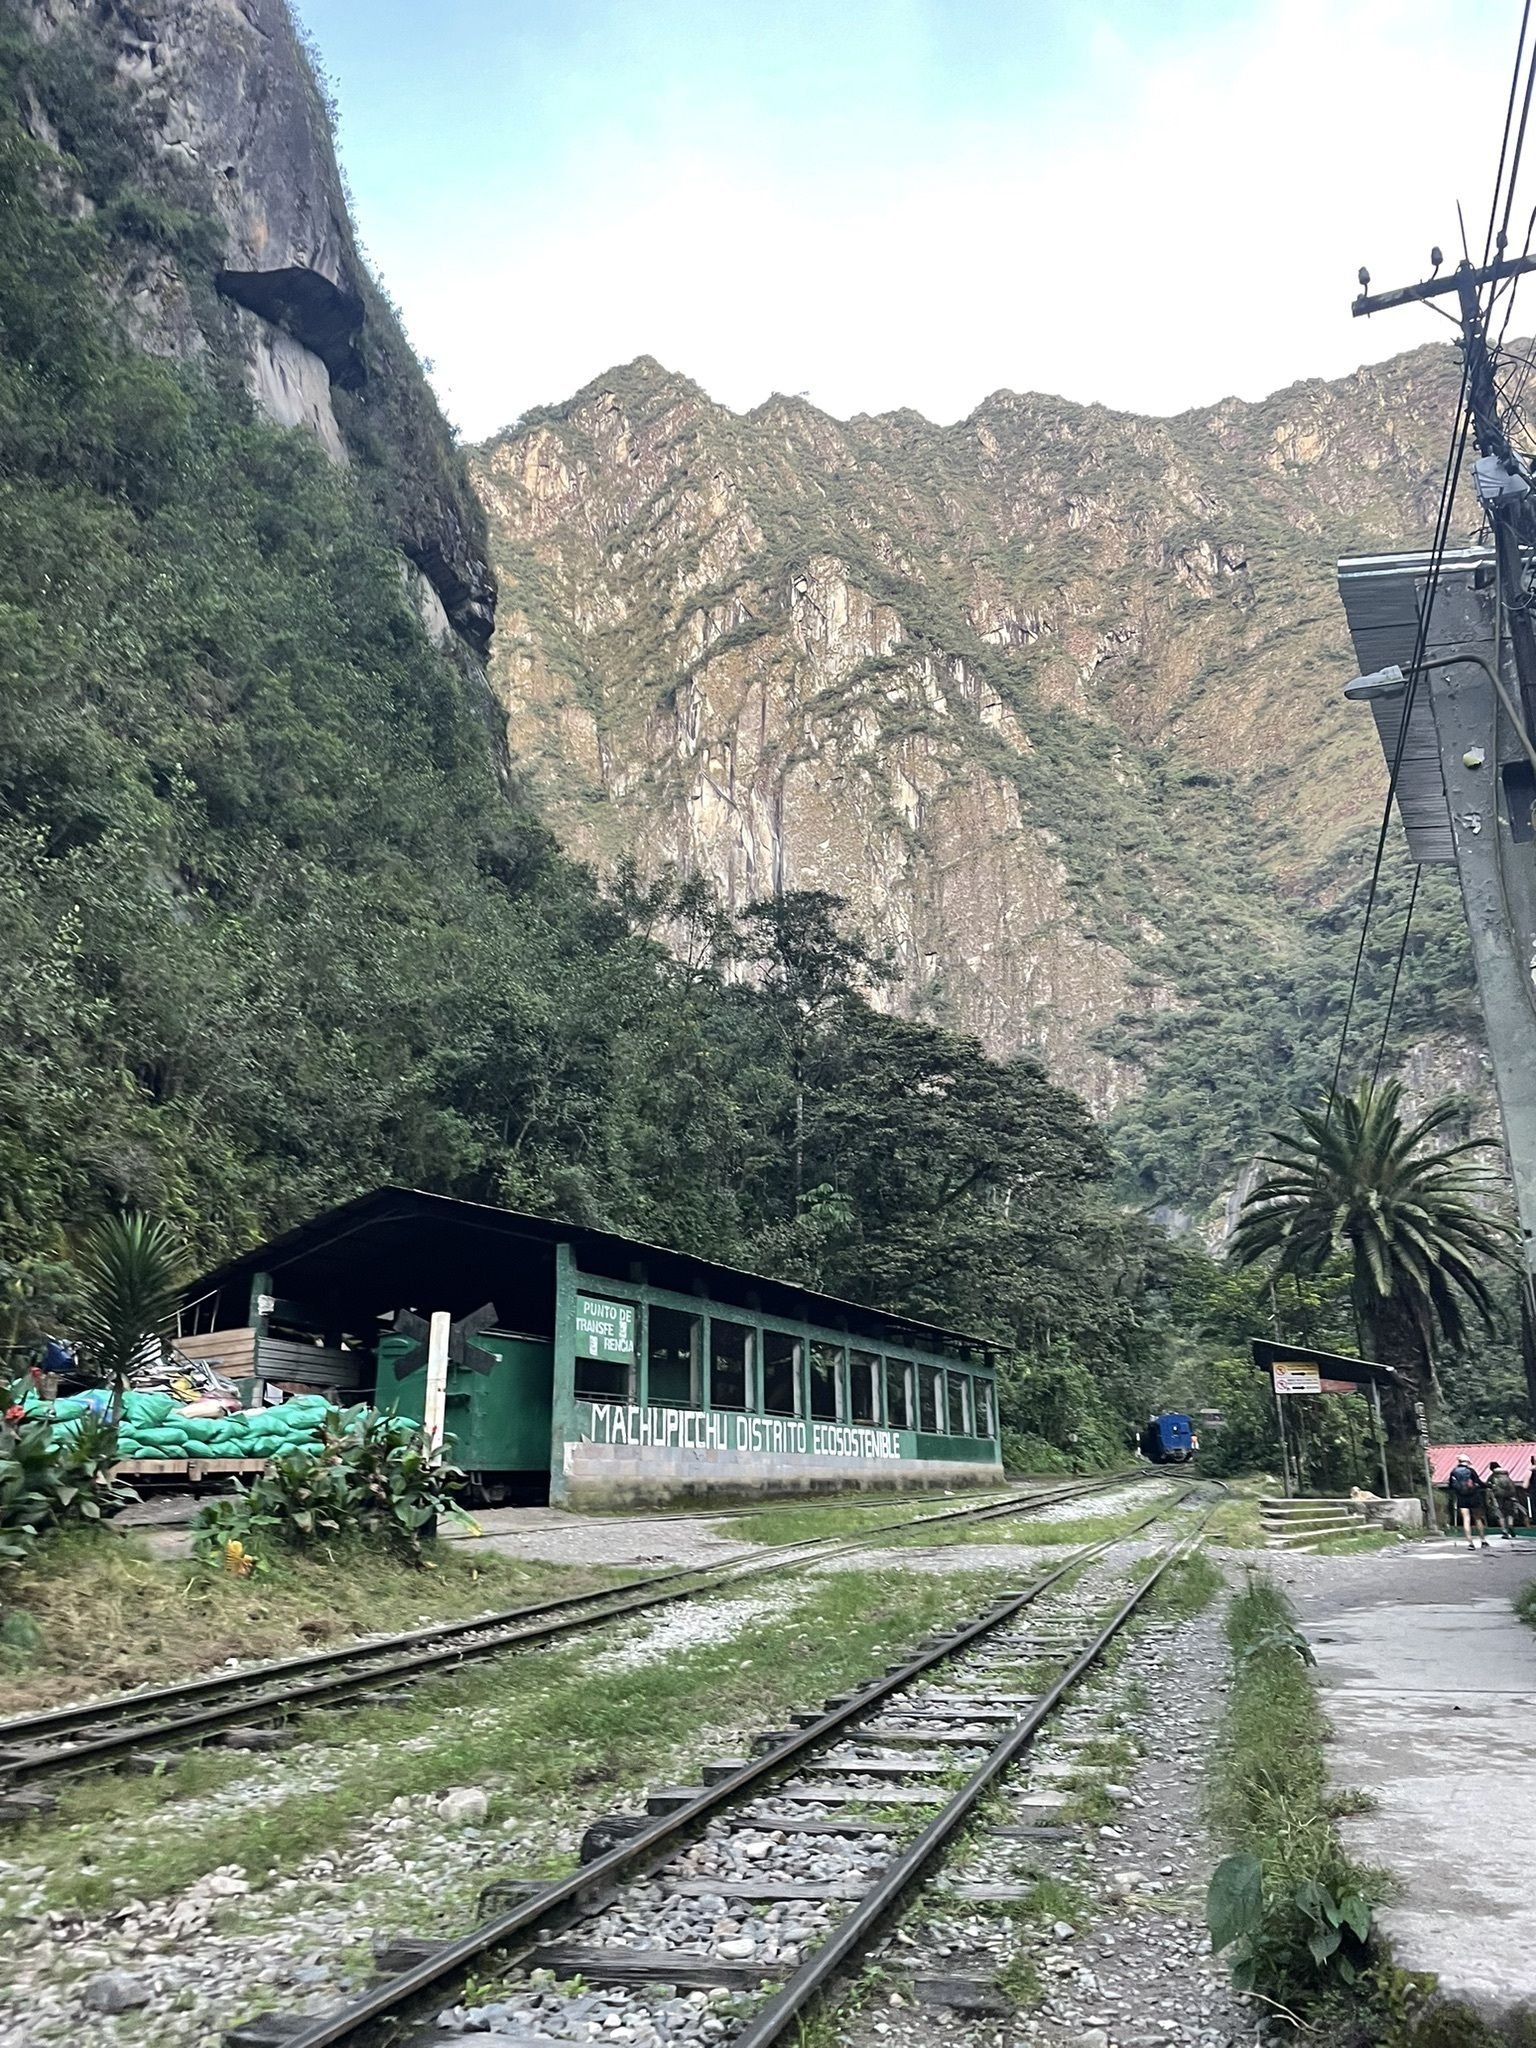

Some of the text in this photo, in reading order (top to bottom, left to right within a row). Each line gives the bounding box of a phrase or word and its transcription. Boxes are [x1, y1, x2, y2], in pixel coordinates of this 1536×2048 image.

[583, 1301, 632, 1323] PUNTO DE
[575, 1317, 615, 1337] TRANSFE
[603, 1337, 634, 1353] RENCIA
[591, 1403, 900, 1459] MACHUPICCHU DISTRITO ECOSOSTENIBLE
